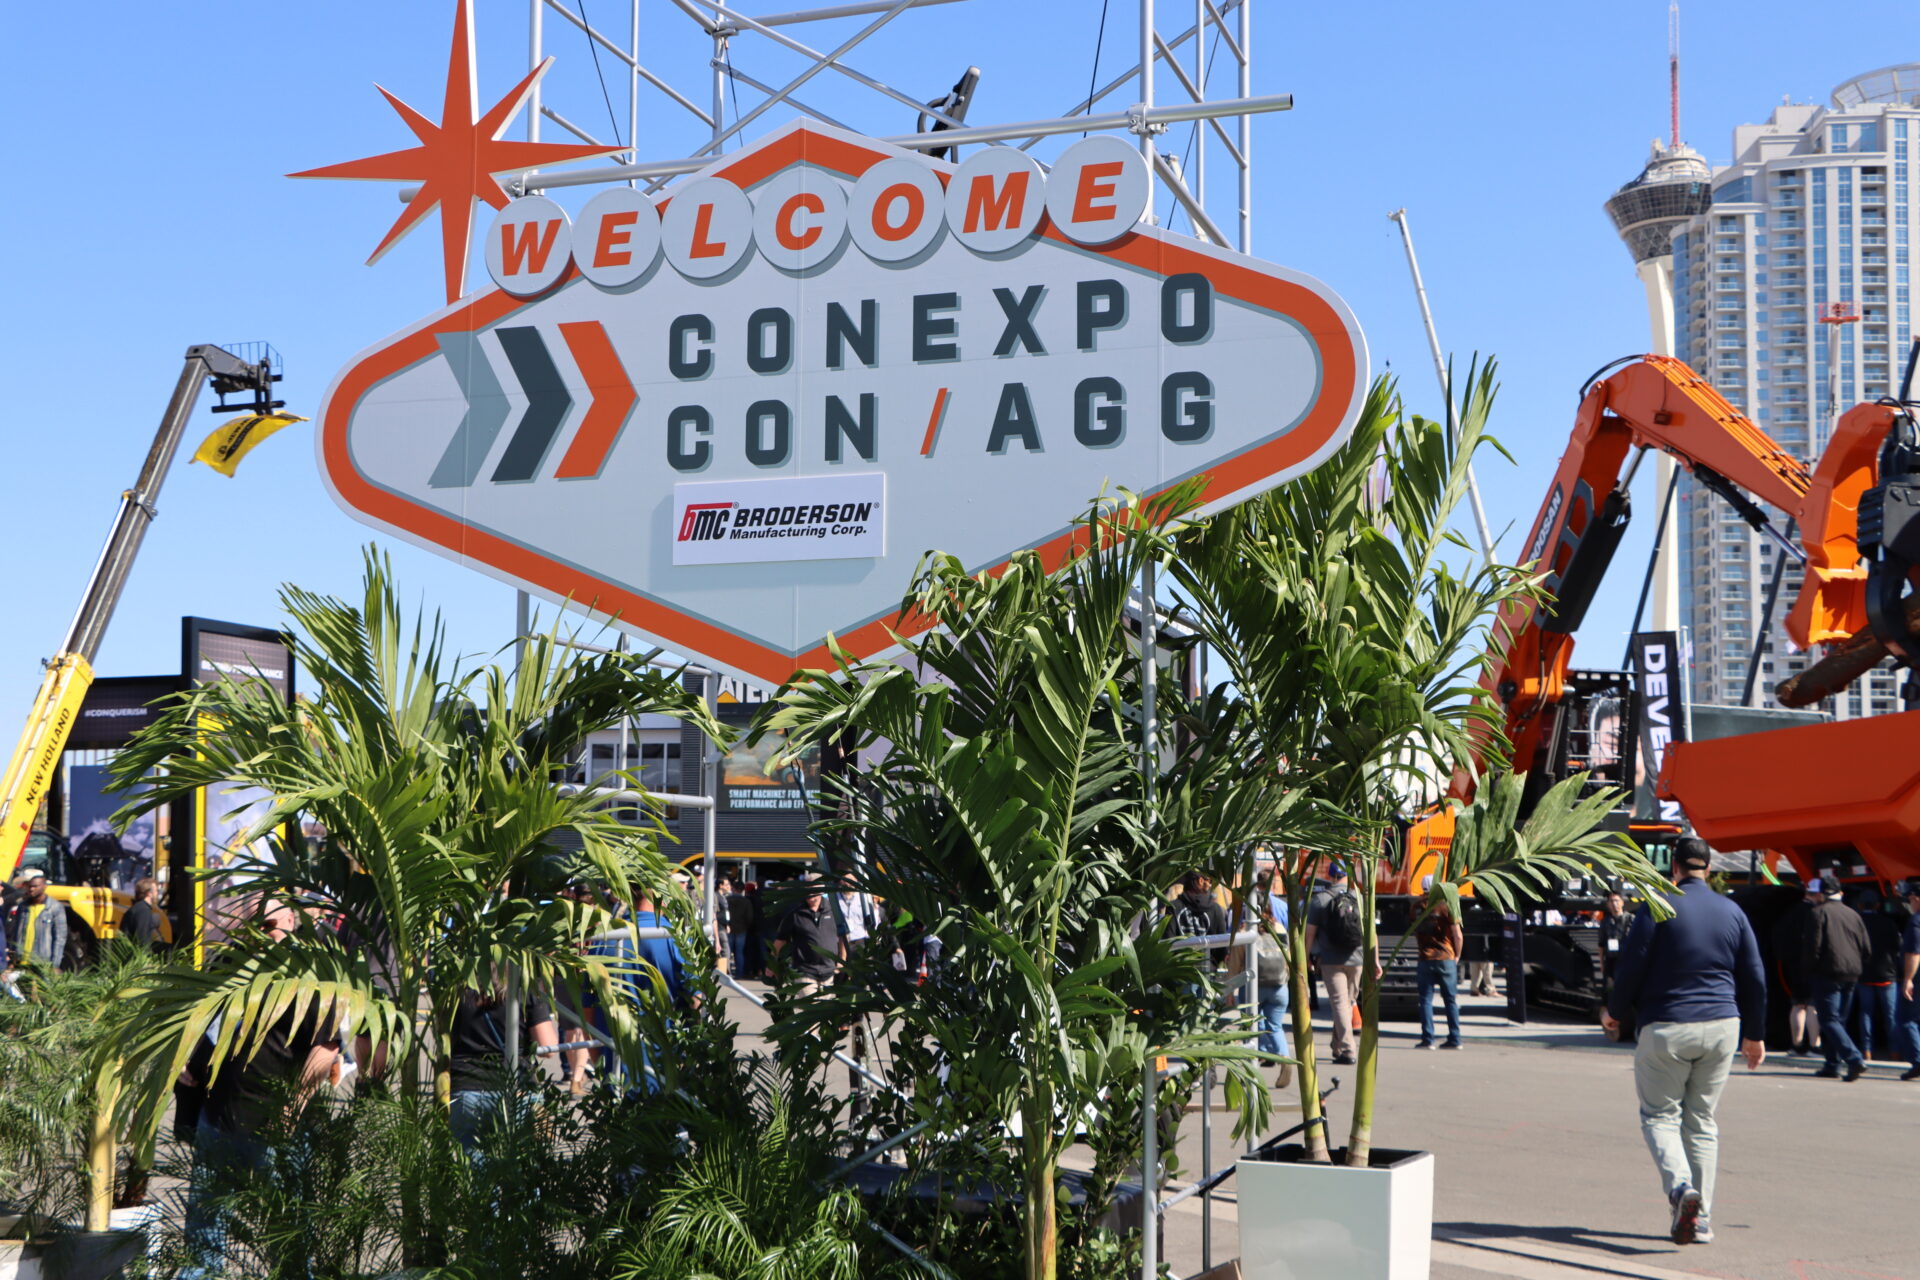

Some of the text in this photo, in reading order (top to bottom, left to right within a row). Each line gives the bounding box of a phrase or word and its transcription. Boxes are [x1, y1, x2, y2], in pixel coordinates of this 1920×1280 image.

[501, 161, 1123, 277] WELCOME
[669, 272, 1211, 379] CONEXPO
[729, 524, 867, 540] Manufacturing Corp.
[26, 707, 71, 805] NEW HOLLAND
[1643, 644, 1682, 822] DEVELN
[729, 788, 751, 799] SMART
[752, 788, 786, 799] MACHINES
[729, 799, 777, 809] PERFORMANCE
[778, 799, 792, 809] AND
